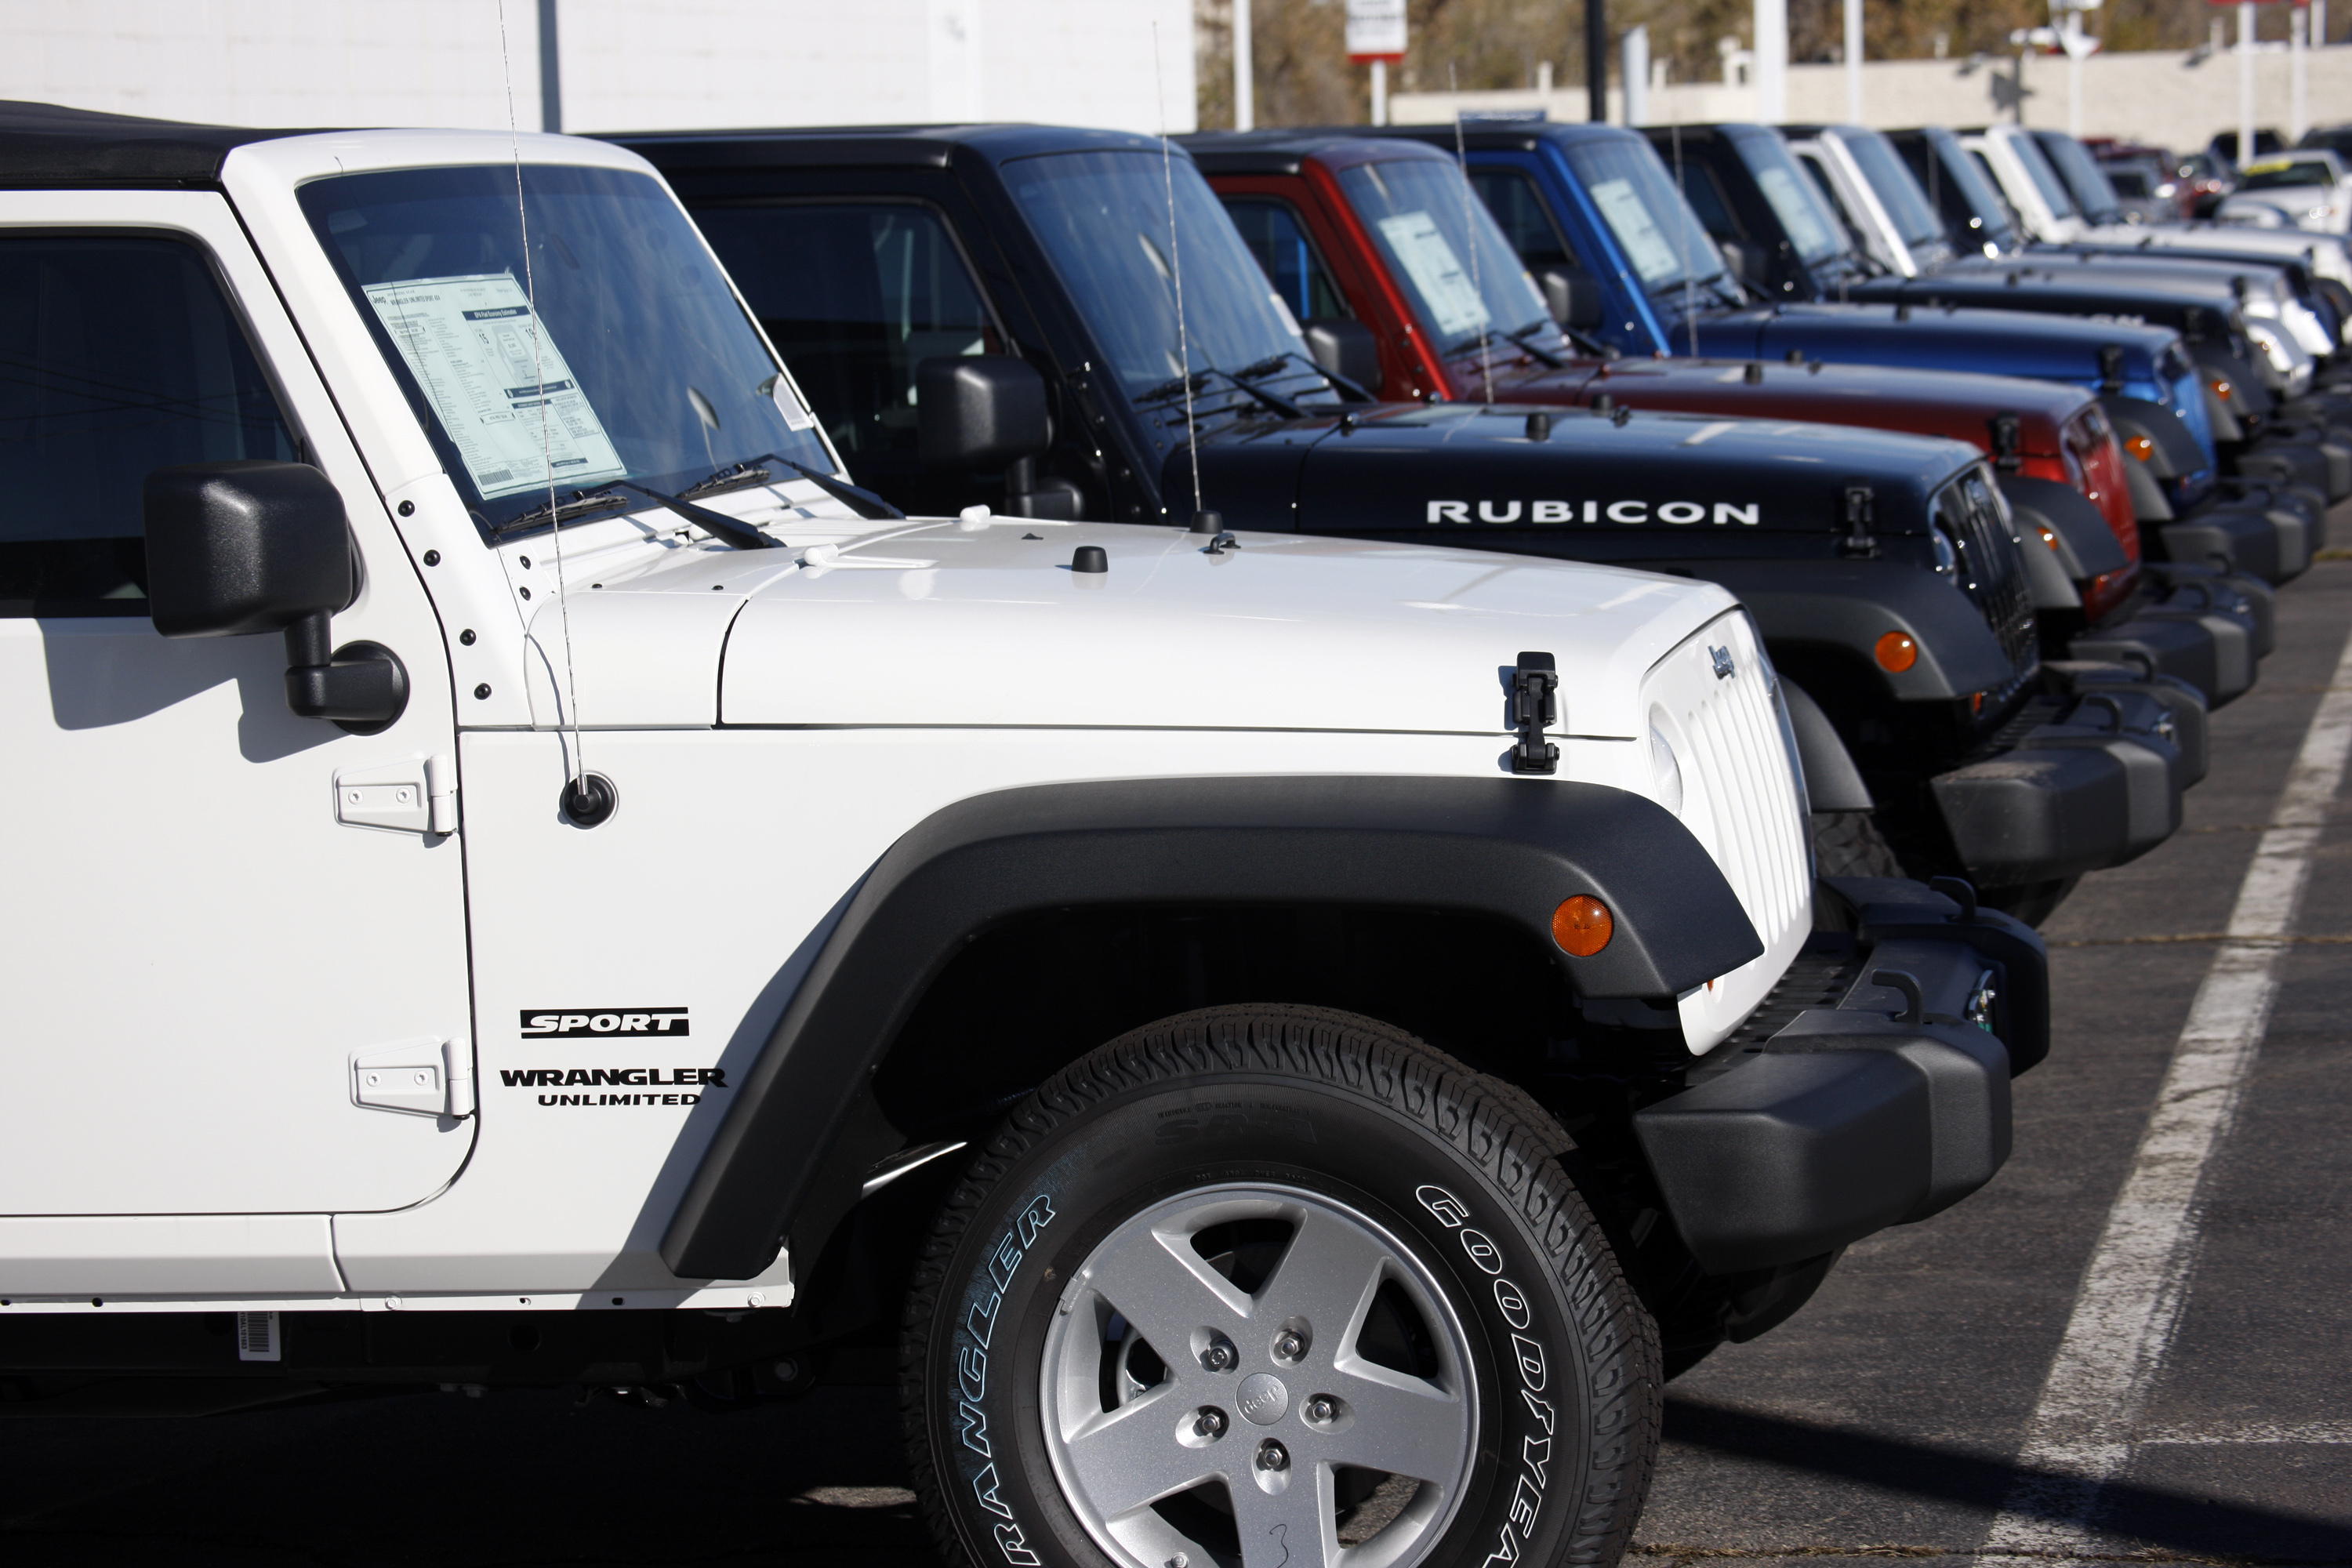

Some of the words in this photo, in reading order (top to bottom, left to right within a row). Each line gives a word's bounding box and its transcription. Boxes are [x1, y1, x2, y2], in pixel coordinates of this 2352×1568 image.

[479, 333, 489, 344] 15
[1427, 500, 1759, 525] RUBICON
[522, 1012, 688, 1033] SPORT
[499, 1068, 729, 1088] WRANGLER
[538, 1094, 701, 1107] UNLIMITED
[1244, 1384, 1279, 1414] Jeep
